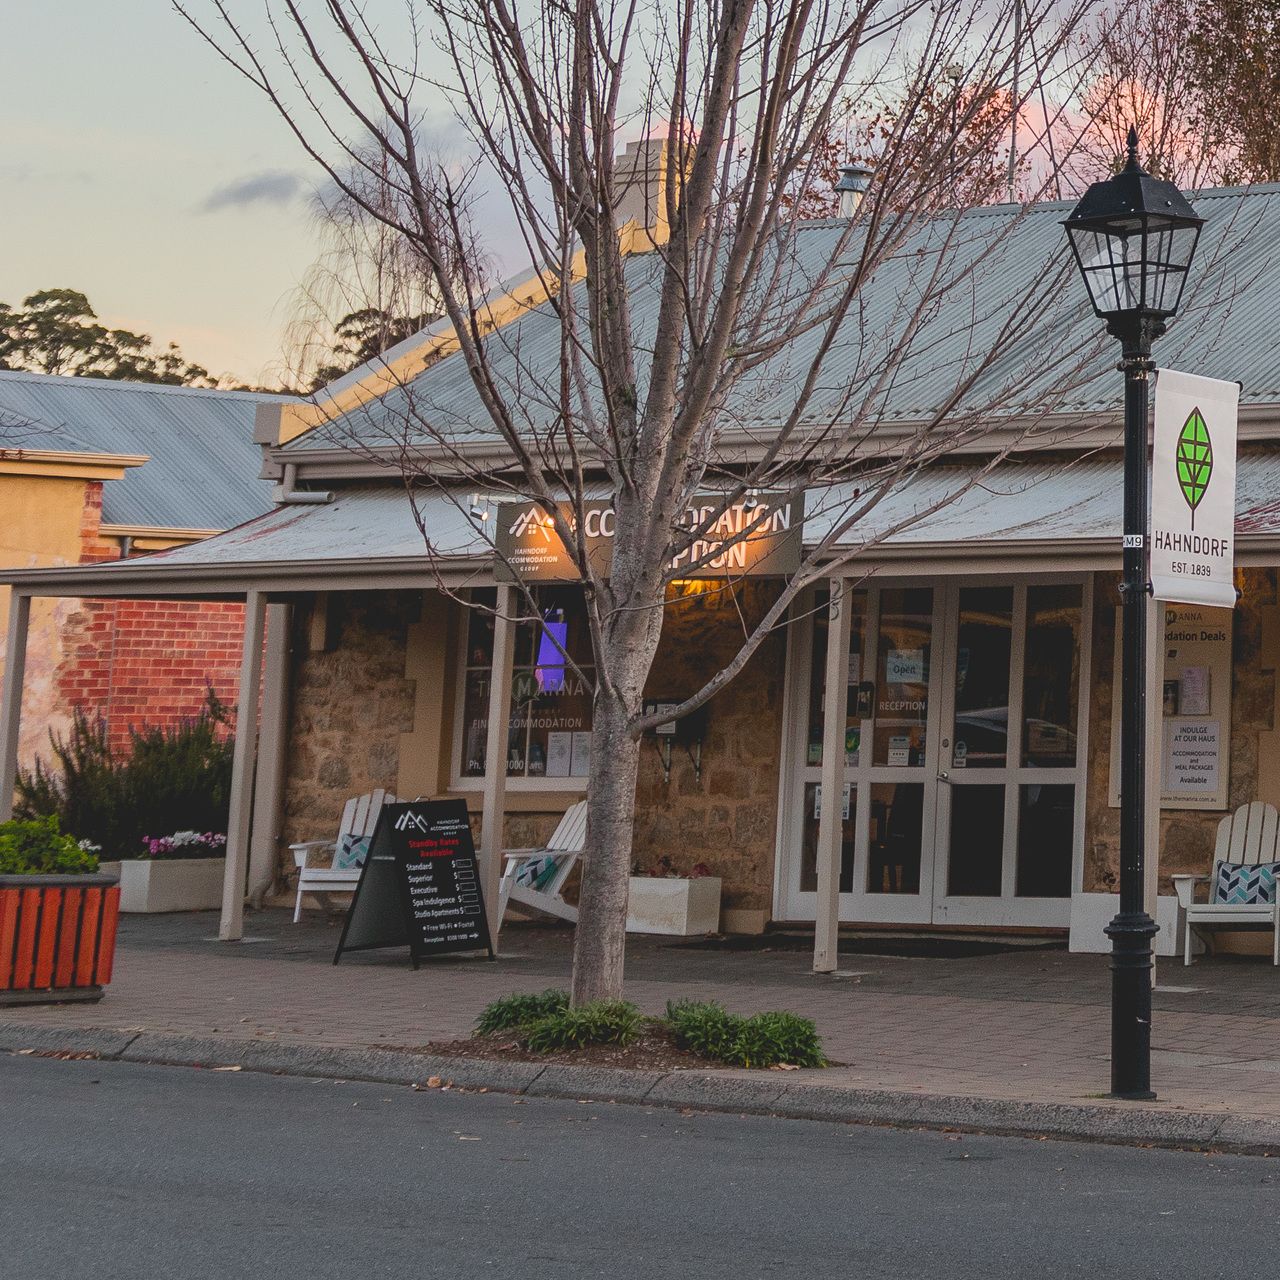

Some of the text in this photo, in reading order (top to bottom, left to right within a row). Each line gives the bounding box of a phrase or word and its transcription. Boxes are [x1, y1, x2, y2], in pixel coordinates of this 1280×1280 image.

[570, 504, 791, 538] CCODATION
[1155, 530, 1228, 557] HAHNDORF
[1172, 561, 1211, 576] EST. 1839
[1200, 631, 1226, 641] Deals
[893, 665, 915, 677] Open
[880, 701, 926, 710] RECEPTION
[472, 718, 582, 729] FIN COMMODATION
[408, 839, 437, 848] Standby
[406, 862, 433, 871] Standard
[408, 874, 433, 883] Superior
[410, 886, 438, 895] Executive
[412, 899, 424, 907] Spa
[424, 897, 456, 906] Indulgence
[414, 910, 430, 918] Studio
[431, 908, 460, 917] Apartments
